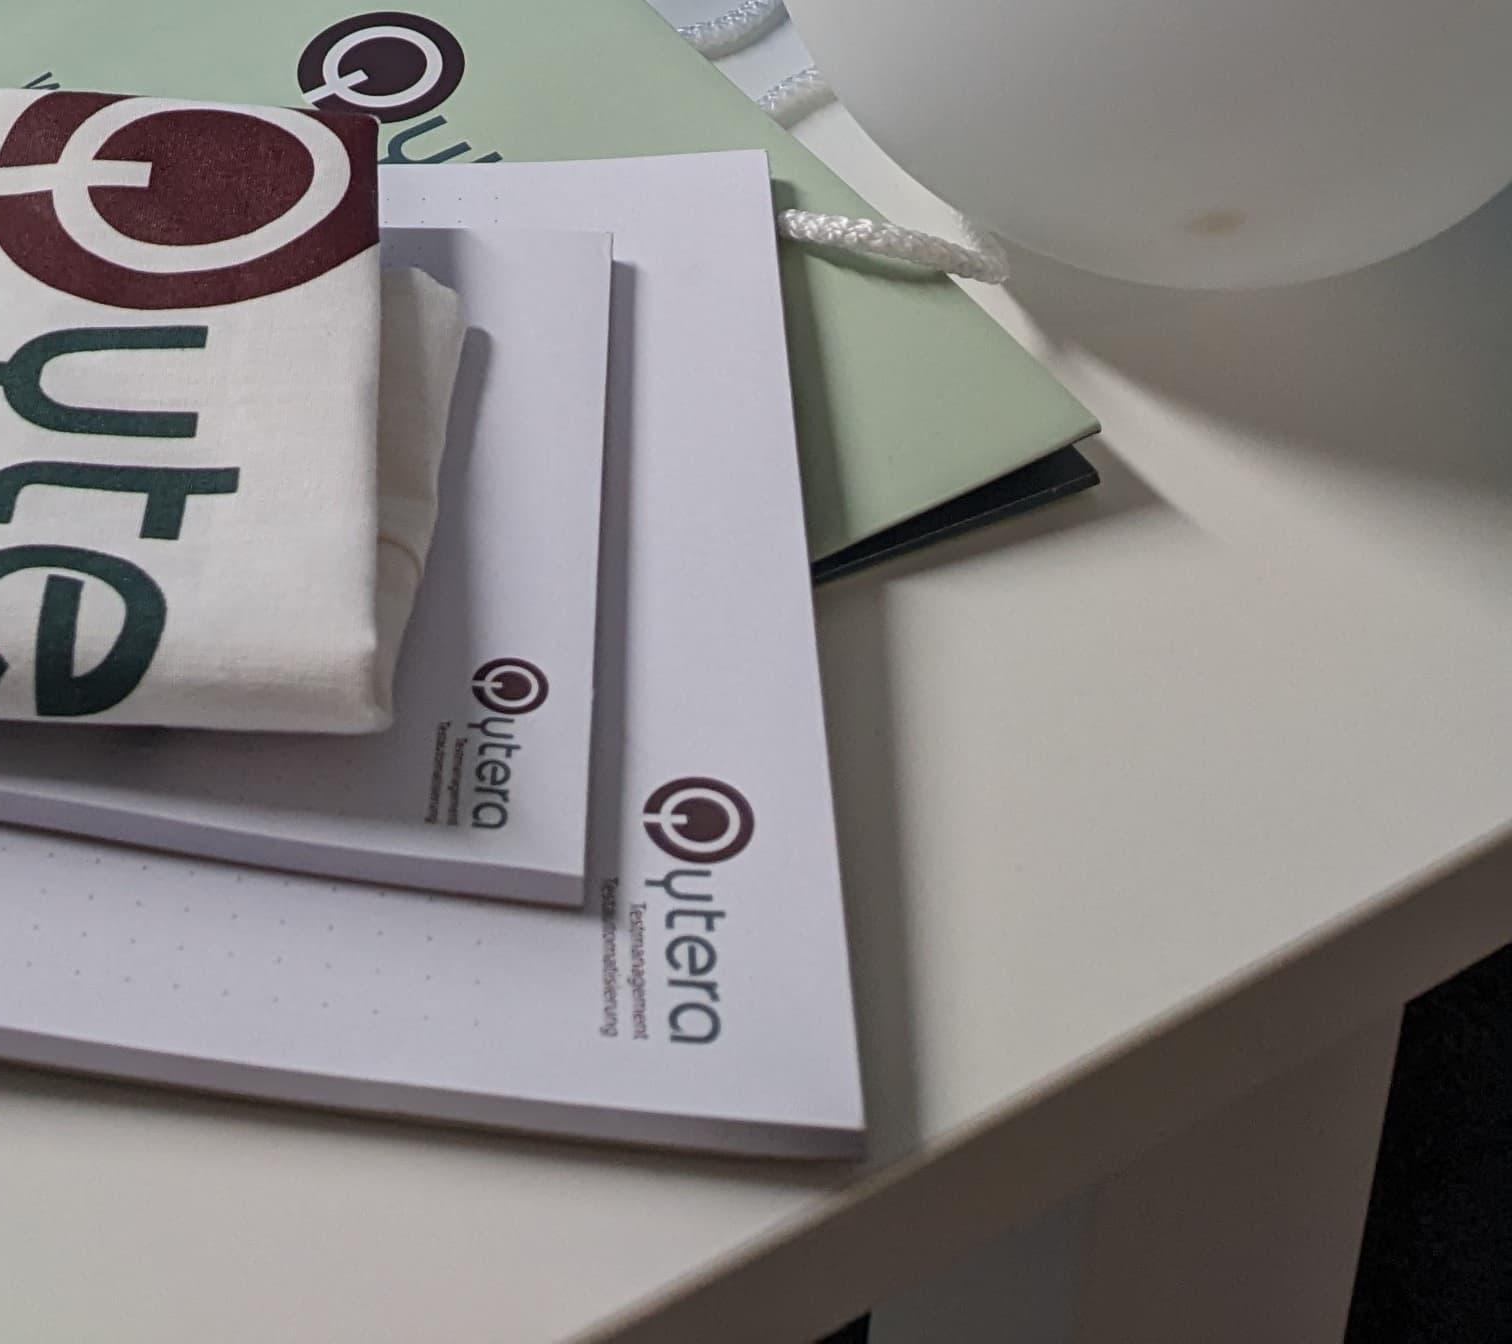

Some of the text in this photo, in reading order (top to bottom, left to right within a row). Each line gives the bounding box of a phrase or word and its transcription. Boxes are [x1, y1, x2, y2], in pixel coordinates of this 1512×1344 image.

[467, 657, 550, 830] Qytera
[627, 901, 649, 1041] Testmanagement
[642, 776, 756, 1045] Qytera
